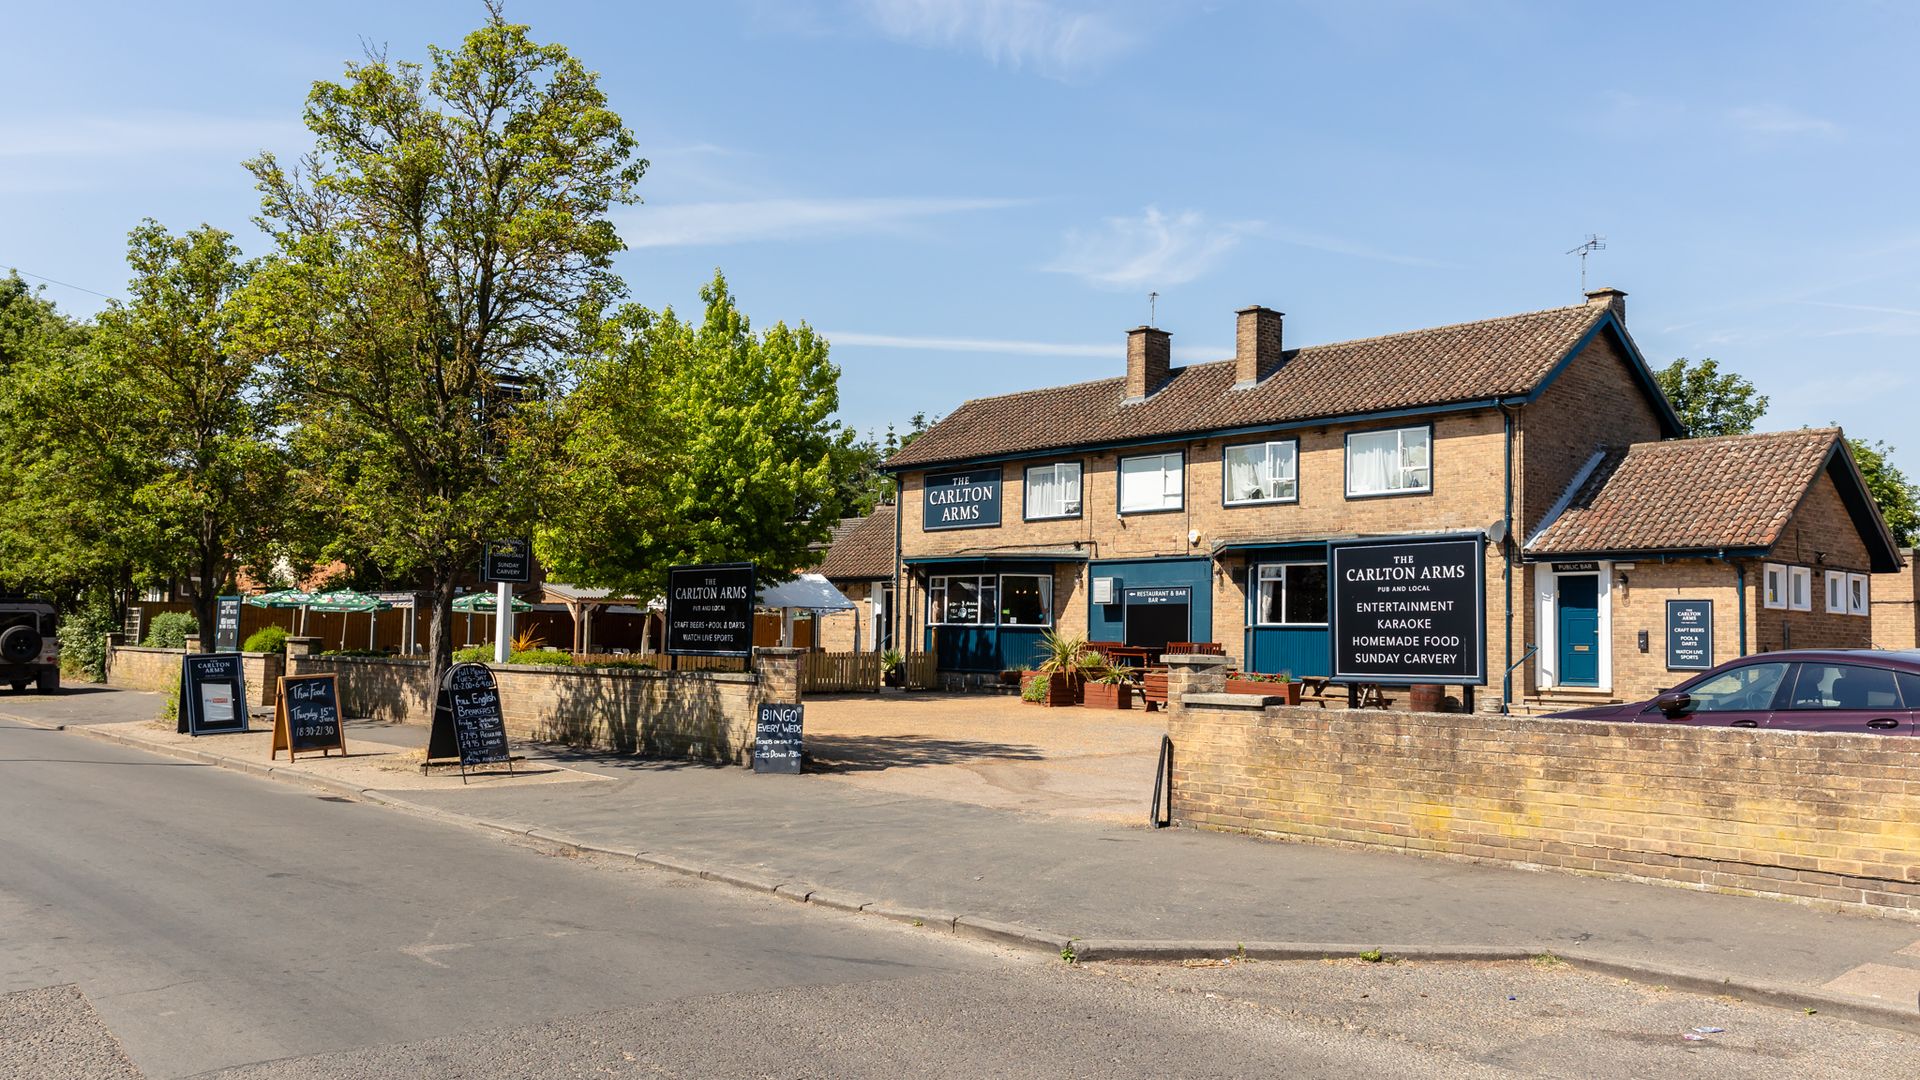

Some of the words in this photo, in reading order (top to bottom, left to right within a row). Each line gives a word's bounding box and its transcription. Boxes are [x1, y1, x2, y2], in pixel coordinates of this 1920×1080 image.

[953, 477, 969, 486] THE
[929, 486, 993, 505] CARLTON
[942, 505, 979, 522] ARMS
[1394, 556, 1414, 564] THE
[1346, 567, 1416, 581] CARLTON
[1420, 564, 1465, 579] ARMS
[675, 586, 718, 600] CARLTON
[720, 586, 747, 599] ARMS
[1356, 600, 1454, 613] ENTERTAINMENT
[690, 621, 705, 629] BEERS
[708, 621, 722, 629] POOL
[728, 621, 746, 629] DARTS
[1377, 619, 1432, 629] KARAOKE
[682, 633, 701, 641] WATCH
[713, 634, 734, 642] SPORTS
[1352, 636, 1420, 647] HOMEMADE
[1424, 636, 1460, 647] FOOD
[1355, 653, 1400, 664] SUNDAY
[1403, 653, 1458, 664] CARVERY
[289, 683, 309, 699] Thai
[310, 682, 326, 700] Food
[471, 691, 496, 706] English
[762, 708, 798, 722] BINGO
[757, 723, 780, 733] EVERY
[781, 723, 802, 734] WEDS
